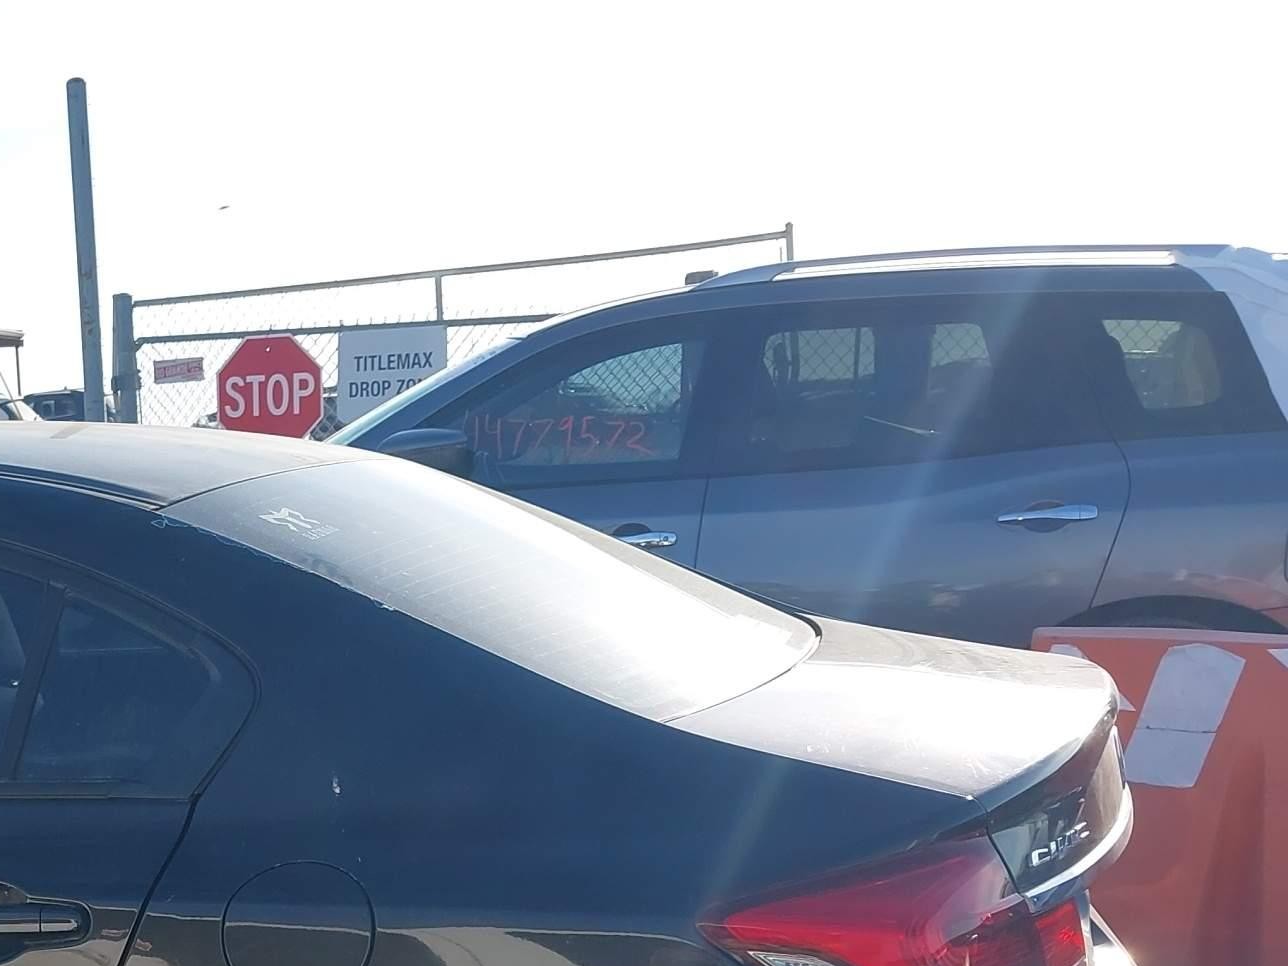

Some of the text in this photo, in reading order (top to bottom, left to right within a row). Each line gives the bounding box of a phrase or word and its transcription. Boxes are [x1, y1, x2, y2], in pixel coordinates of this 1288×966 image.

[354, 352, 433, 371] TITLEMAX
[224, 372, 316, 418] STOP
[349, 380, 392, 398] DROP
